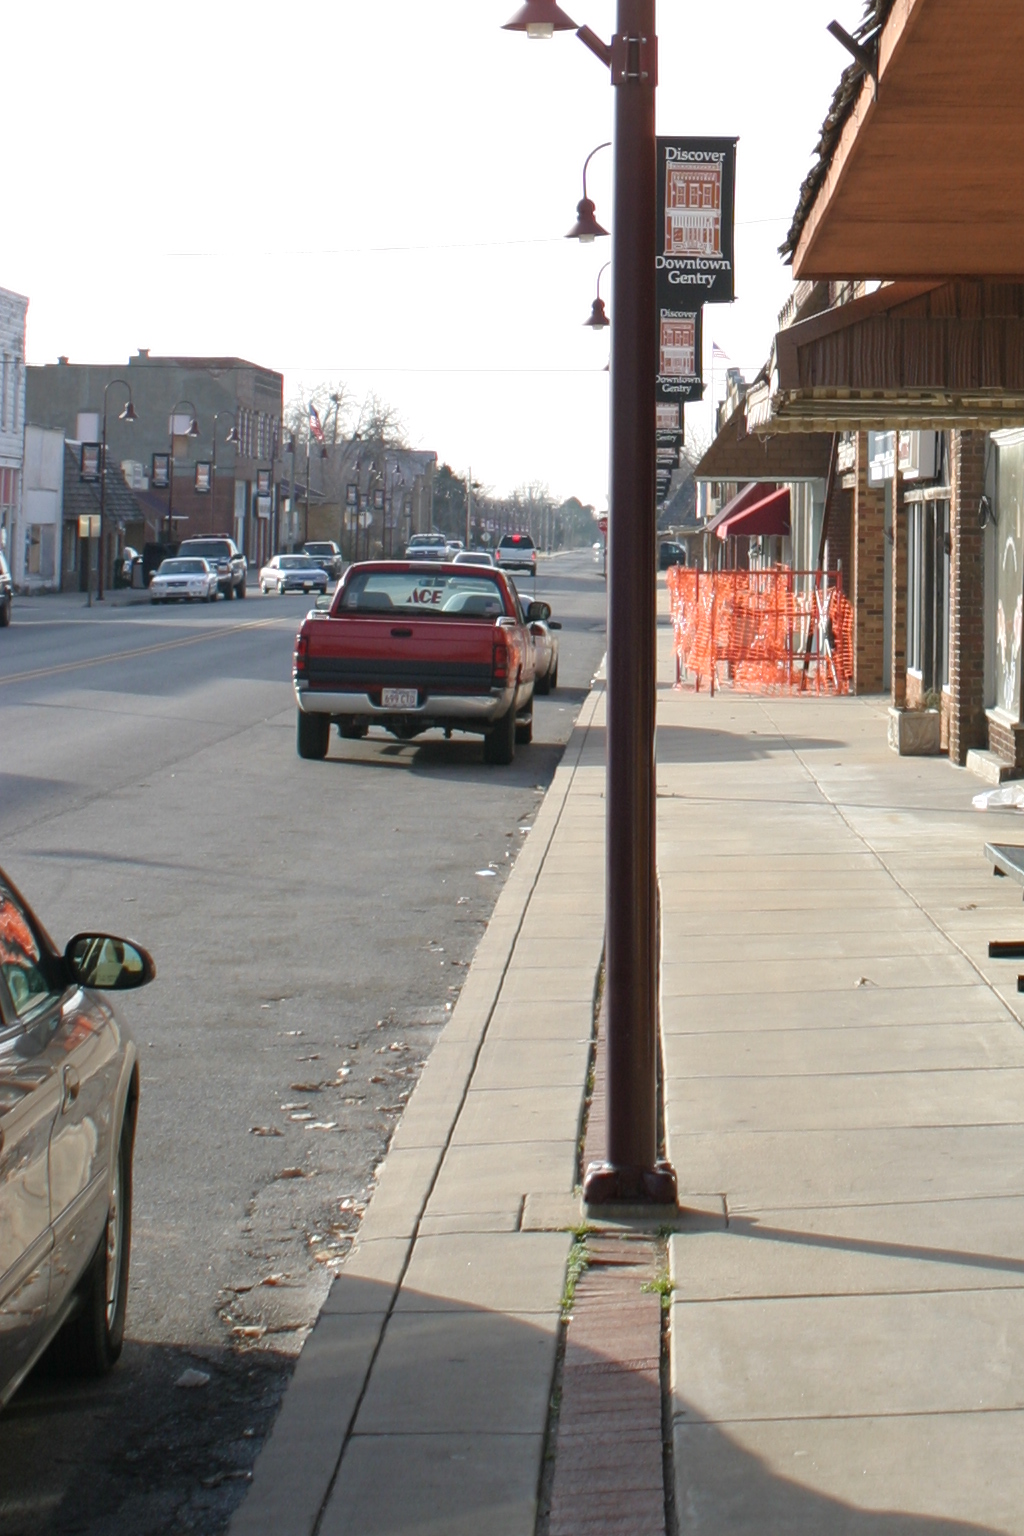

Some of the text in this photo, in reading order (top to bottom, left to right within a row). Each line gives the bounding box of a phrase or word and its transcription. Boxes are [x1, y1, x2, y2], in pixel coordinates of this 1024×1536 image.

[665, 146, 726, 162] Discover
[655, 255, 732, 271] Downtown
[668, 270, 717, 288] Gentry
[660, 308, 698, 319] Discover
[661, 383, 692, 395] Gentry
[406, 587, 444, 604] ACE
